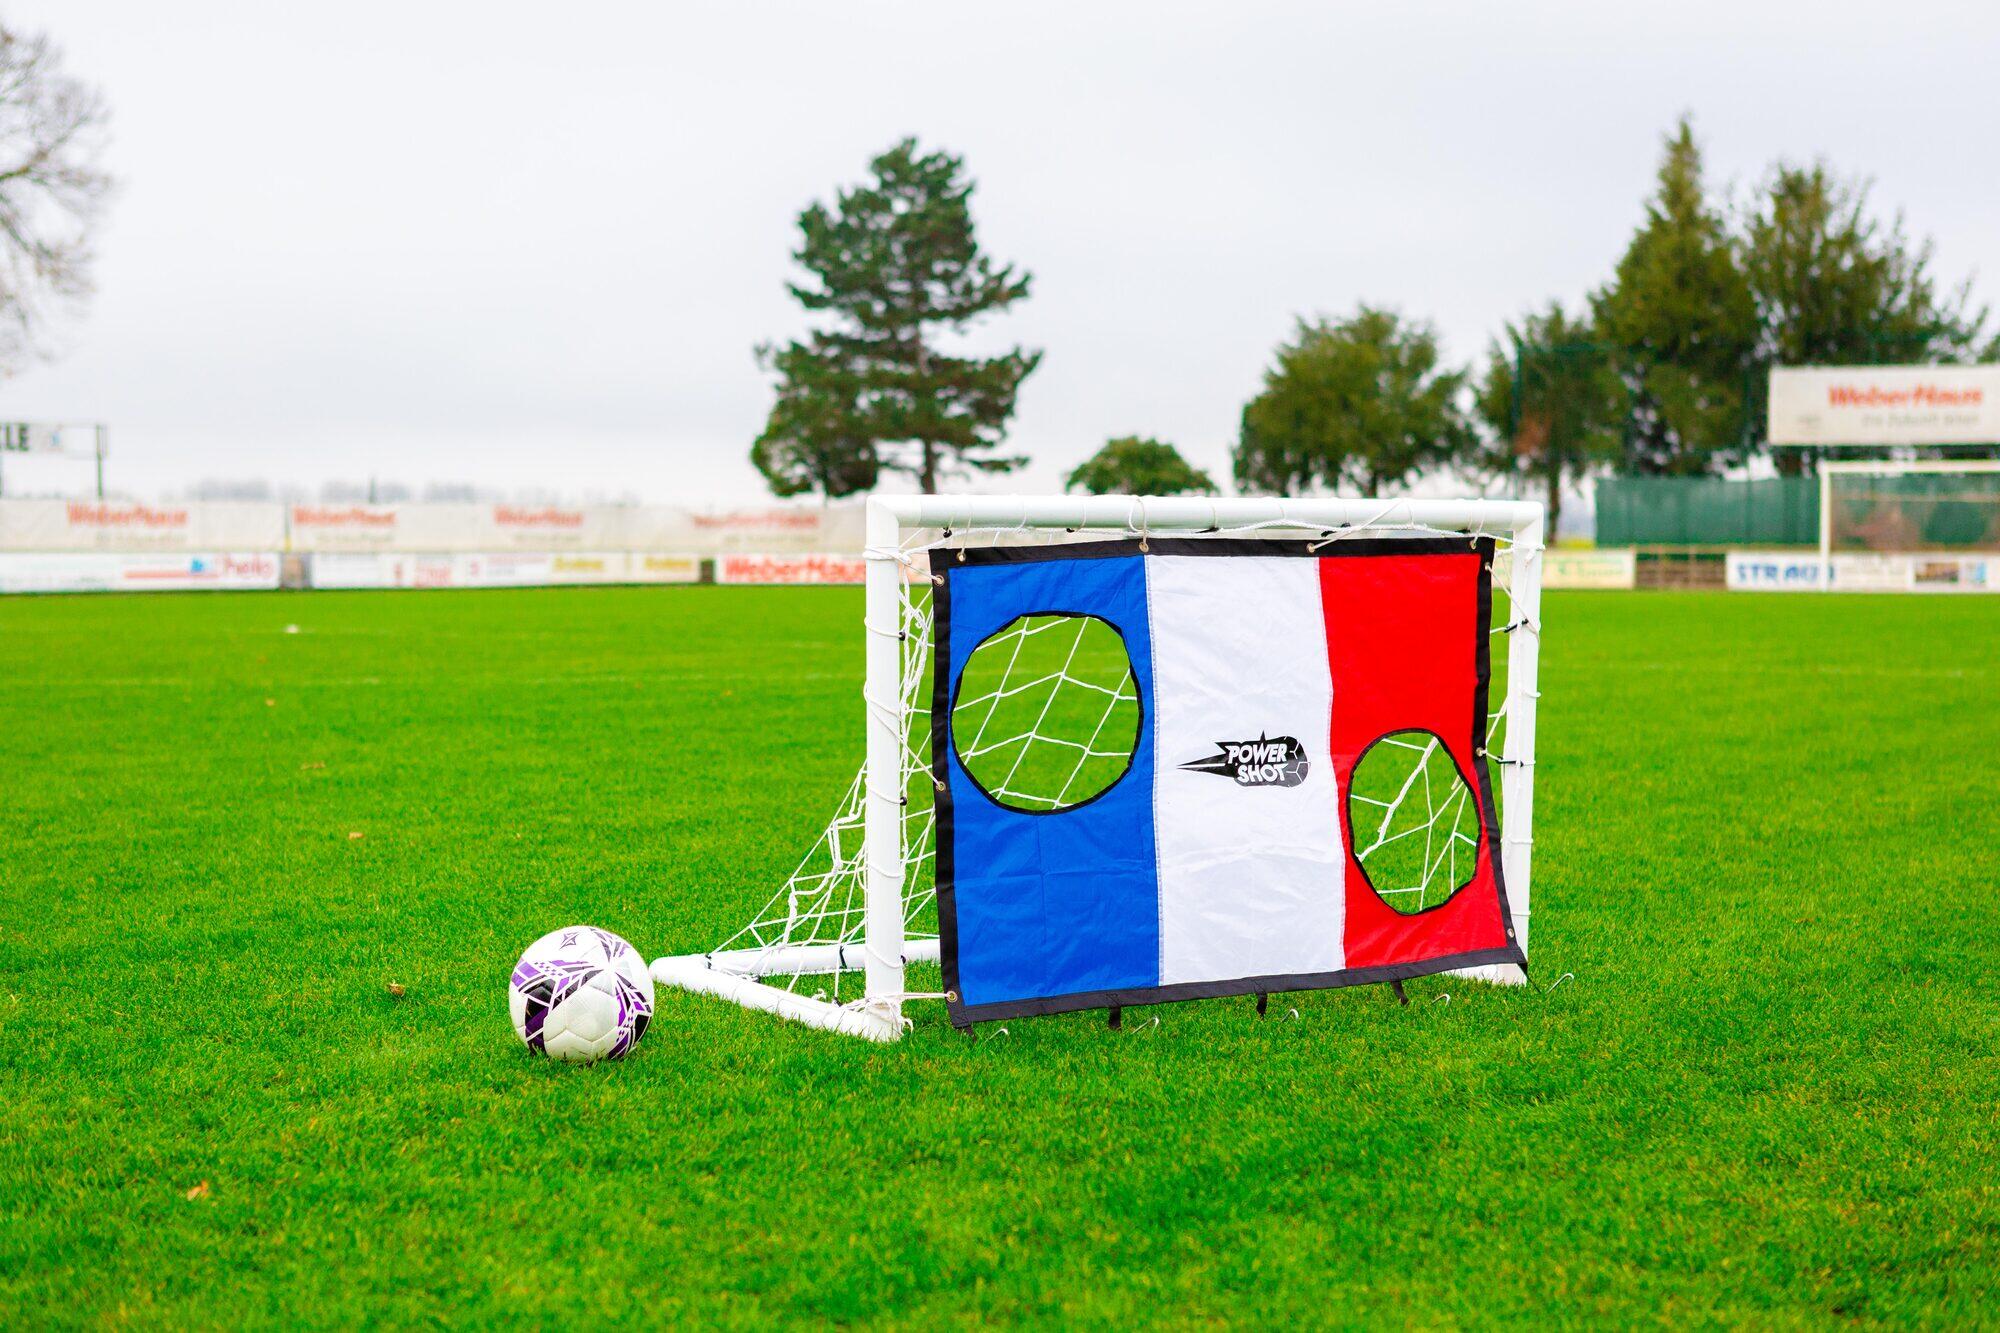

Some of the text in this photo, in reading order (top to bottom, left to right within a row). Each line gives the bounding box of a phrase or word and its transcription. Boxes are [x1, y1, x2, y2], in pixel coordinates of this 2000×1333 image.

[0, 422, 29, 451] LE
[1225, 742, 1288, 766] POWER
[1237, 763, 1288, 783] SHOT
